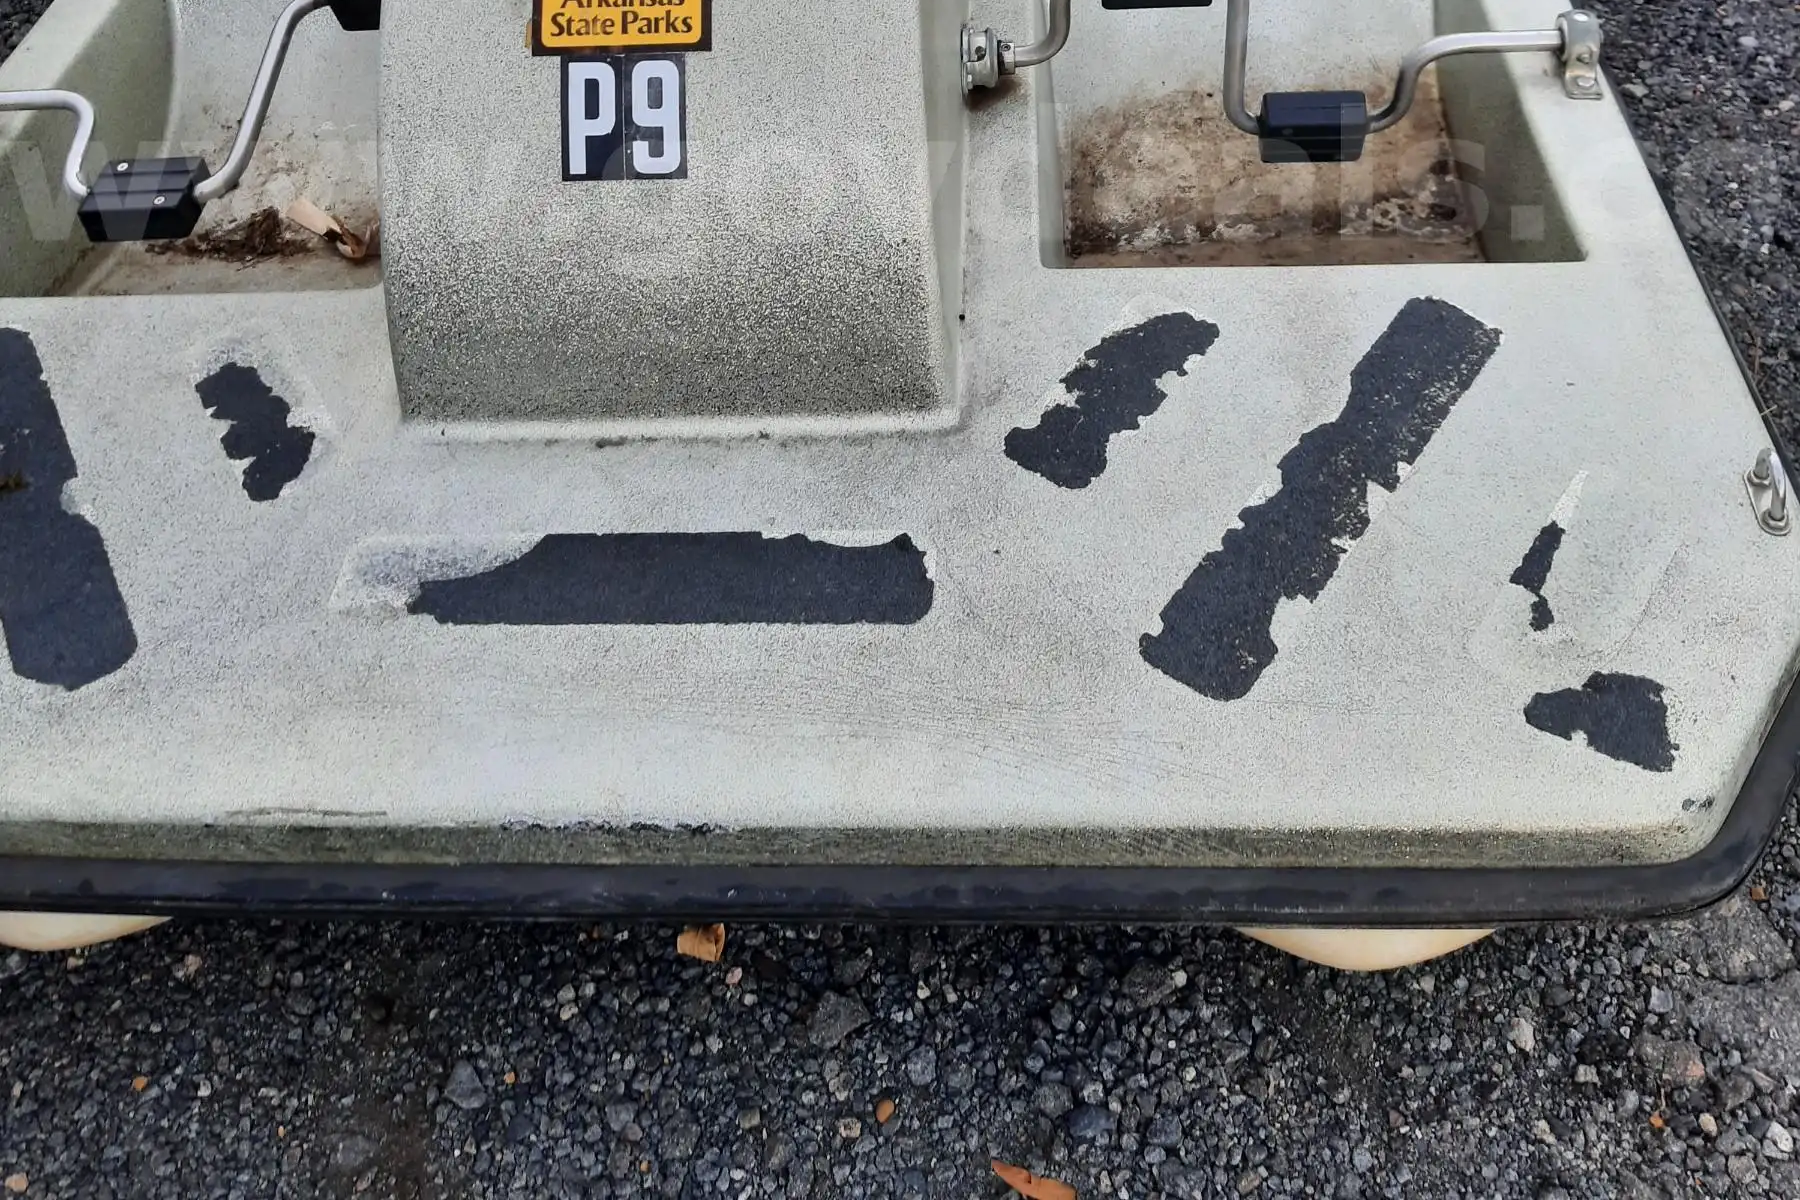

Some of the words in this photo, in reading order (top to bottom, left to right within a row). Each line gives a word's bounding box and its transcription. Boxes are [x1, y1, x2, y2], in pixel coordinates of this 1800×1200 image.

[549, 10, 616, 38] State
[620, 9, 693, 36] Parks
[567, 59, 681, 175] P9
